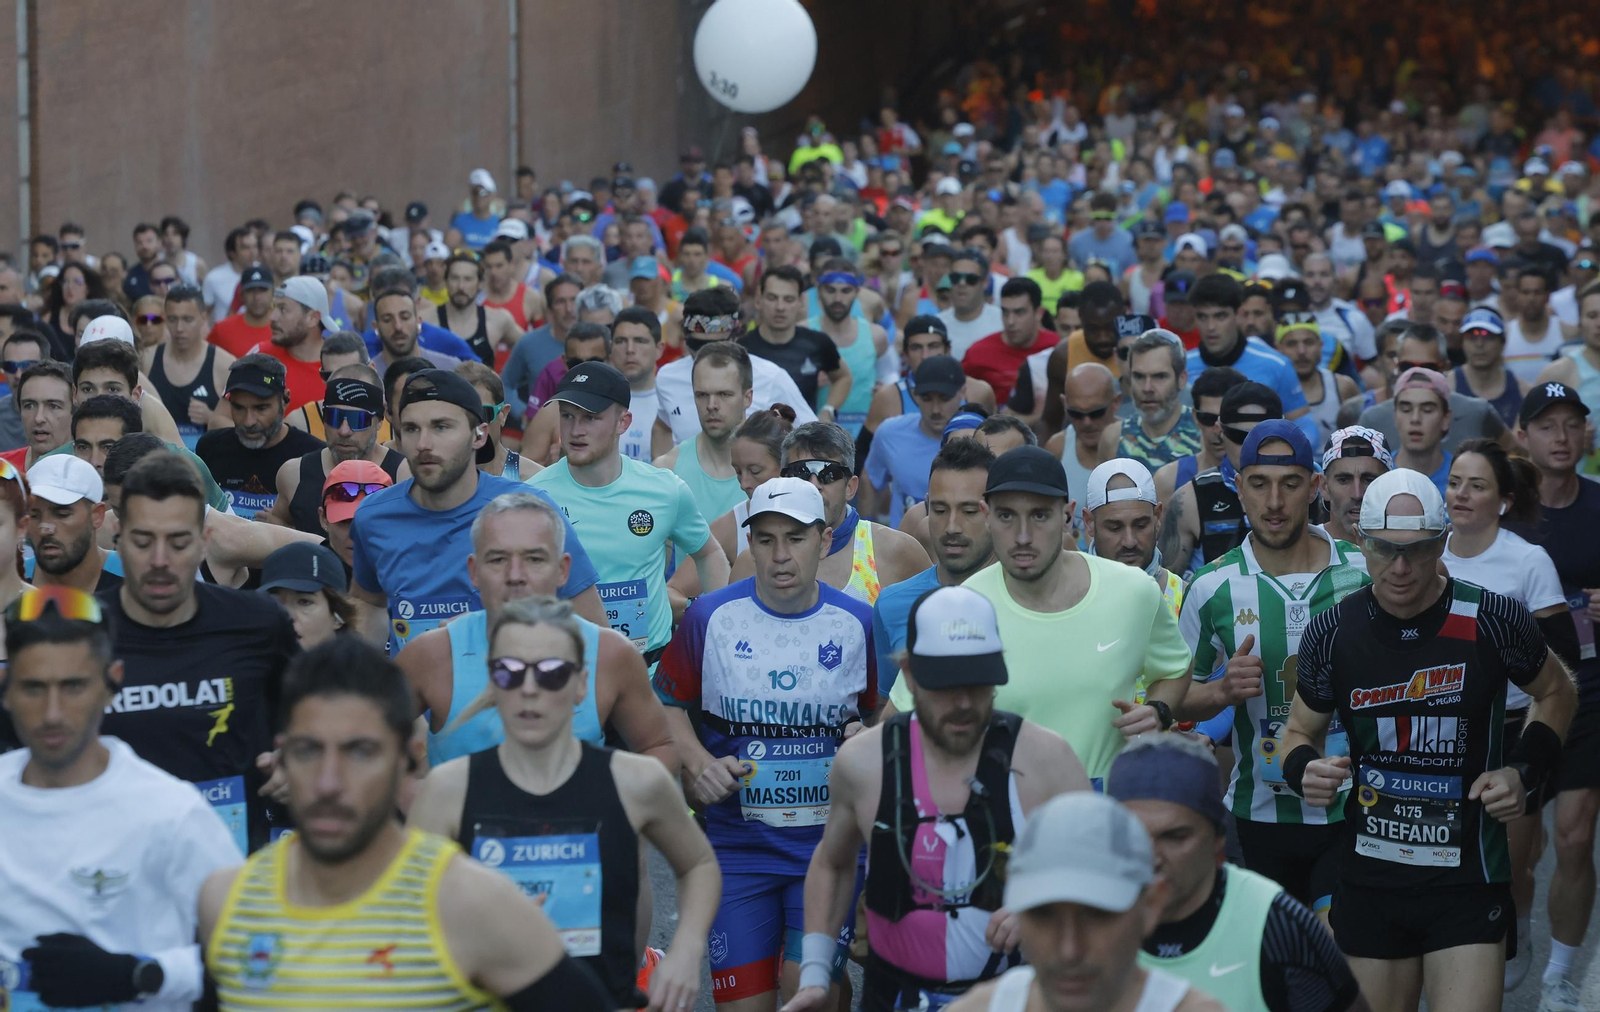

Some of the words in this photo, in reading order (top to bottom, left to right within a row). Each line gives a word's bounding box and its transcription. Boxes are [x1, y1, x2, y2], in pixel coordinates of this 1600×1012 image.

[238, 496, 274, 508] ZURICH
[420, 602, 469, 615] ZURICH
[768, 670, 797, 691] 10
[1435, 695, 1461, 706] PEGASO
[719, 695, 848, 727] INFORMALES
[1457, 716, 1469, 754] SPORT
[772, 742, 824, 756] ZURICH
[774, 770, 801, 782] 7201
[1391, 777, 1449, 794] ZURICH
[745, 785, 830, 804] MASSIMO
[1393, 804, 1422, 818] 4175
[1366, 815, 1450, 844] STEFANO
[512, 842, 586, 861] ZURICH
